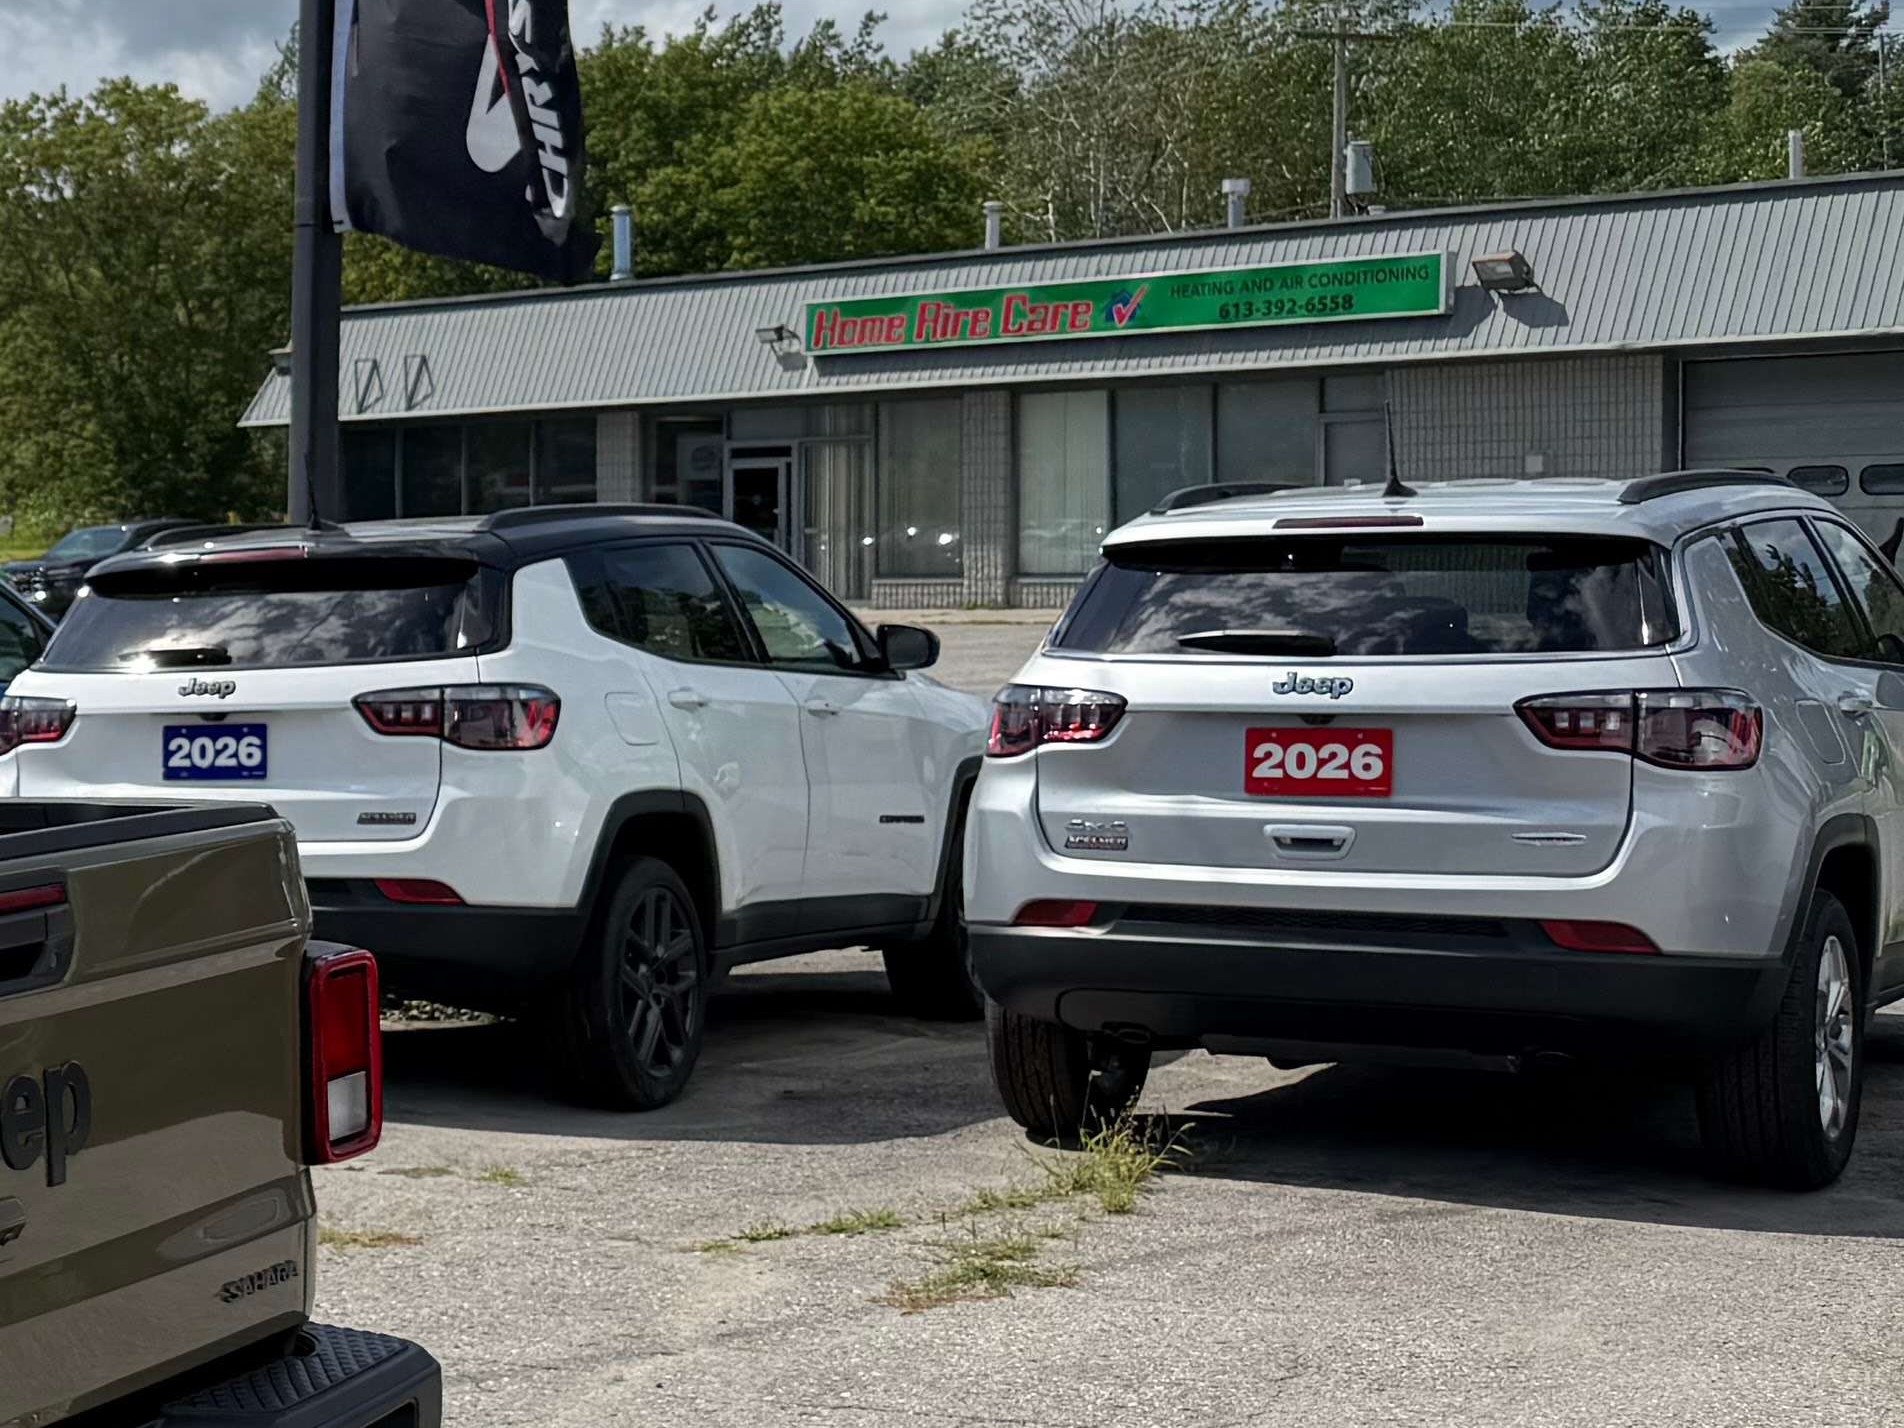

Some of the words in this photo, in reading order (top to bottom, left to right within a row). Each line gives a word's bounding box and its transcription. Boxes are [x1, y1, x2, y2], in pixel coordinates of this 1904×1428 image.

[1169, 280, 1235, 299] HEATING
[1239, 278, 1275, 294] AND
[1278, 274, 1305, 290] AIR
[1308, 264, 1430, 289] CONDITIONING
[811, 308, 906, 350] Home
[1000, 293, 1093, 337] Care
[1218, 294, 1355, 321] 613-392-6558
[178, 677, 237, 700] Jeep
[1272, 671, 1354, 700] Jeep
[167, 735, 263, 769] 2026
[1251, 742, 1384, 781] 2026
